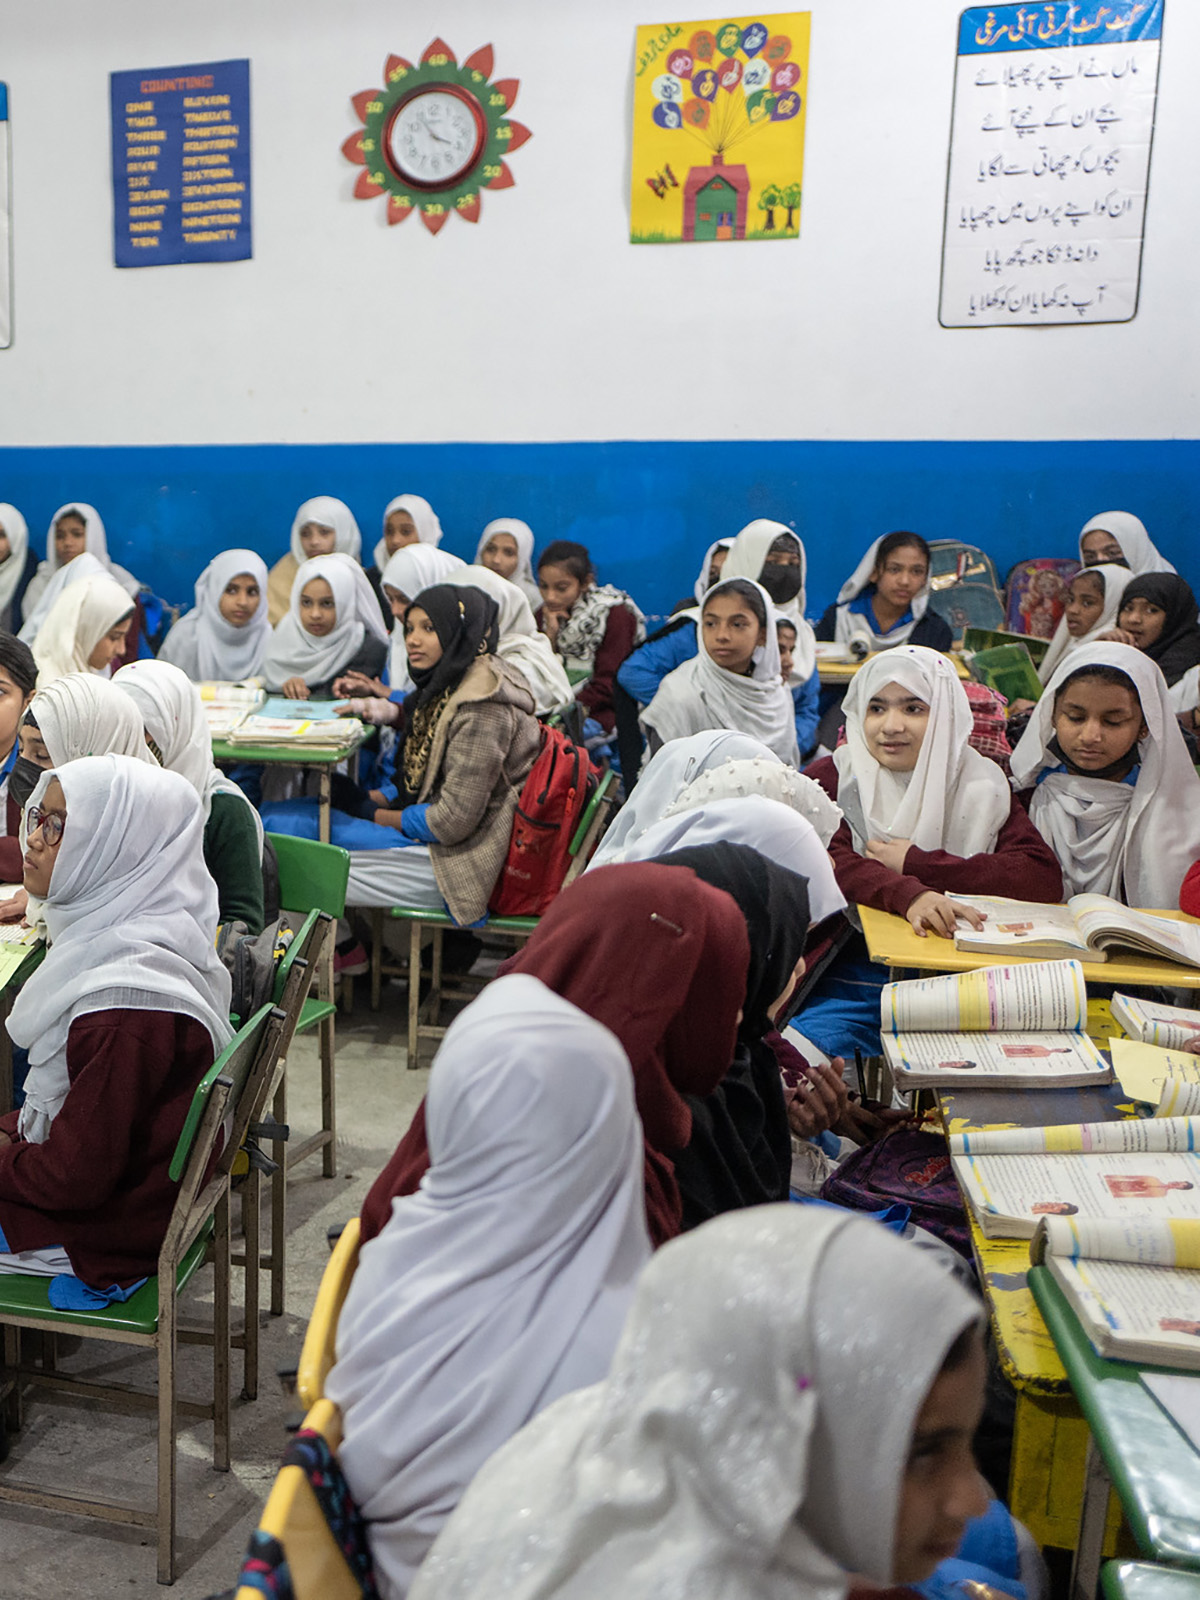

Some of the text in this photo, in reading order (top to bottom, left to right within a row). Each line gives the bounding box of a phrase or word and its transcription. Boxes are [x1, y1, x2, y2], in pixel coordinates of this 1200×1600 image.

[975, 12, 1009, 46] مرغی
[1008, 8, 1039, 42] آئی
[1038, 6, 1080, 41] کرتی
[428, 53, 448, 67] 60
[1084, 57, 1107, 78] نے
[1111, 57, 1138, 78] ماں
[141, 75, 214, 93] COUNTING
[1036, 70, 1046, 90] پر
[1048, 62, 1083, 90] اپنے
[126, 101, 154, 113] ONE
[183, 94, 230, 107] ELEVEN
[365, 101, 384, 114] 50
[488, 93, 506, 107] 10
[126, 116, 157, 127] TWO
[1014, 108, 1042, 139] نیچے
[1044, 104, 1069, 127] کے
[1071, 107, 1094, 128] ان
[1096, 103, 1122, 134] بچے
[126, 130, 166, 142] THREE
[495, 125, 514, 140] 15
[127, 145, 160, 157] FOUR
[356, 138, 376, 152] 45
[127, 161, 157, 172] FIVE
[482, 165, 503, 178] 20
[977, 145, 1121, 183] بچوں کو چھاتی سے لگایا
[128, 176, 150, 188] SIX
[129, 189, 169, 202] SEVEN
[392, 195, 412, 209] 35
[456, 193, 476, 210] 25
[129, 204, 166, 216] EIGHT
[425, 203, 445, 217] 30
[998, 202, 1023, 224] میں
[1025, 205, 1062, 226] پروں
[1064, 199, 1098, 226] اپنے
[1108, 197, 1133, 219] ان
[129, 220, 162, 232] NINE
[959, 205, 996, 232] چھپایا
[131, 236, 158, 247] TEN
[1006, 239, 1035, 267] کچھ
[1030, 249, 1044, 265] جو
[984, 250, 1002, 275] پایا
[968, 285, 1006, 317] کھلایا
[1008, 294, 1031, 313] ان
[1030, 284, 1067, 314] کھایا
[1059, 294, 1070, 307] نہ
[1071, 285, 1107, 316] آپ
